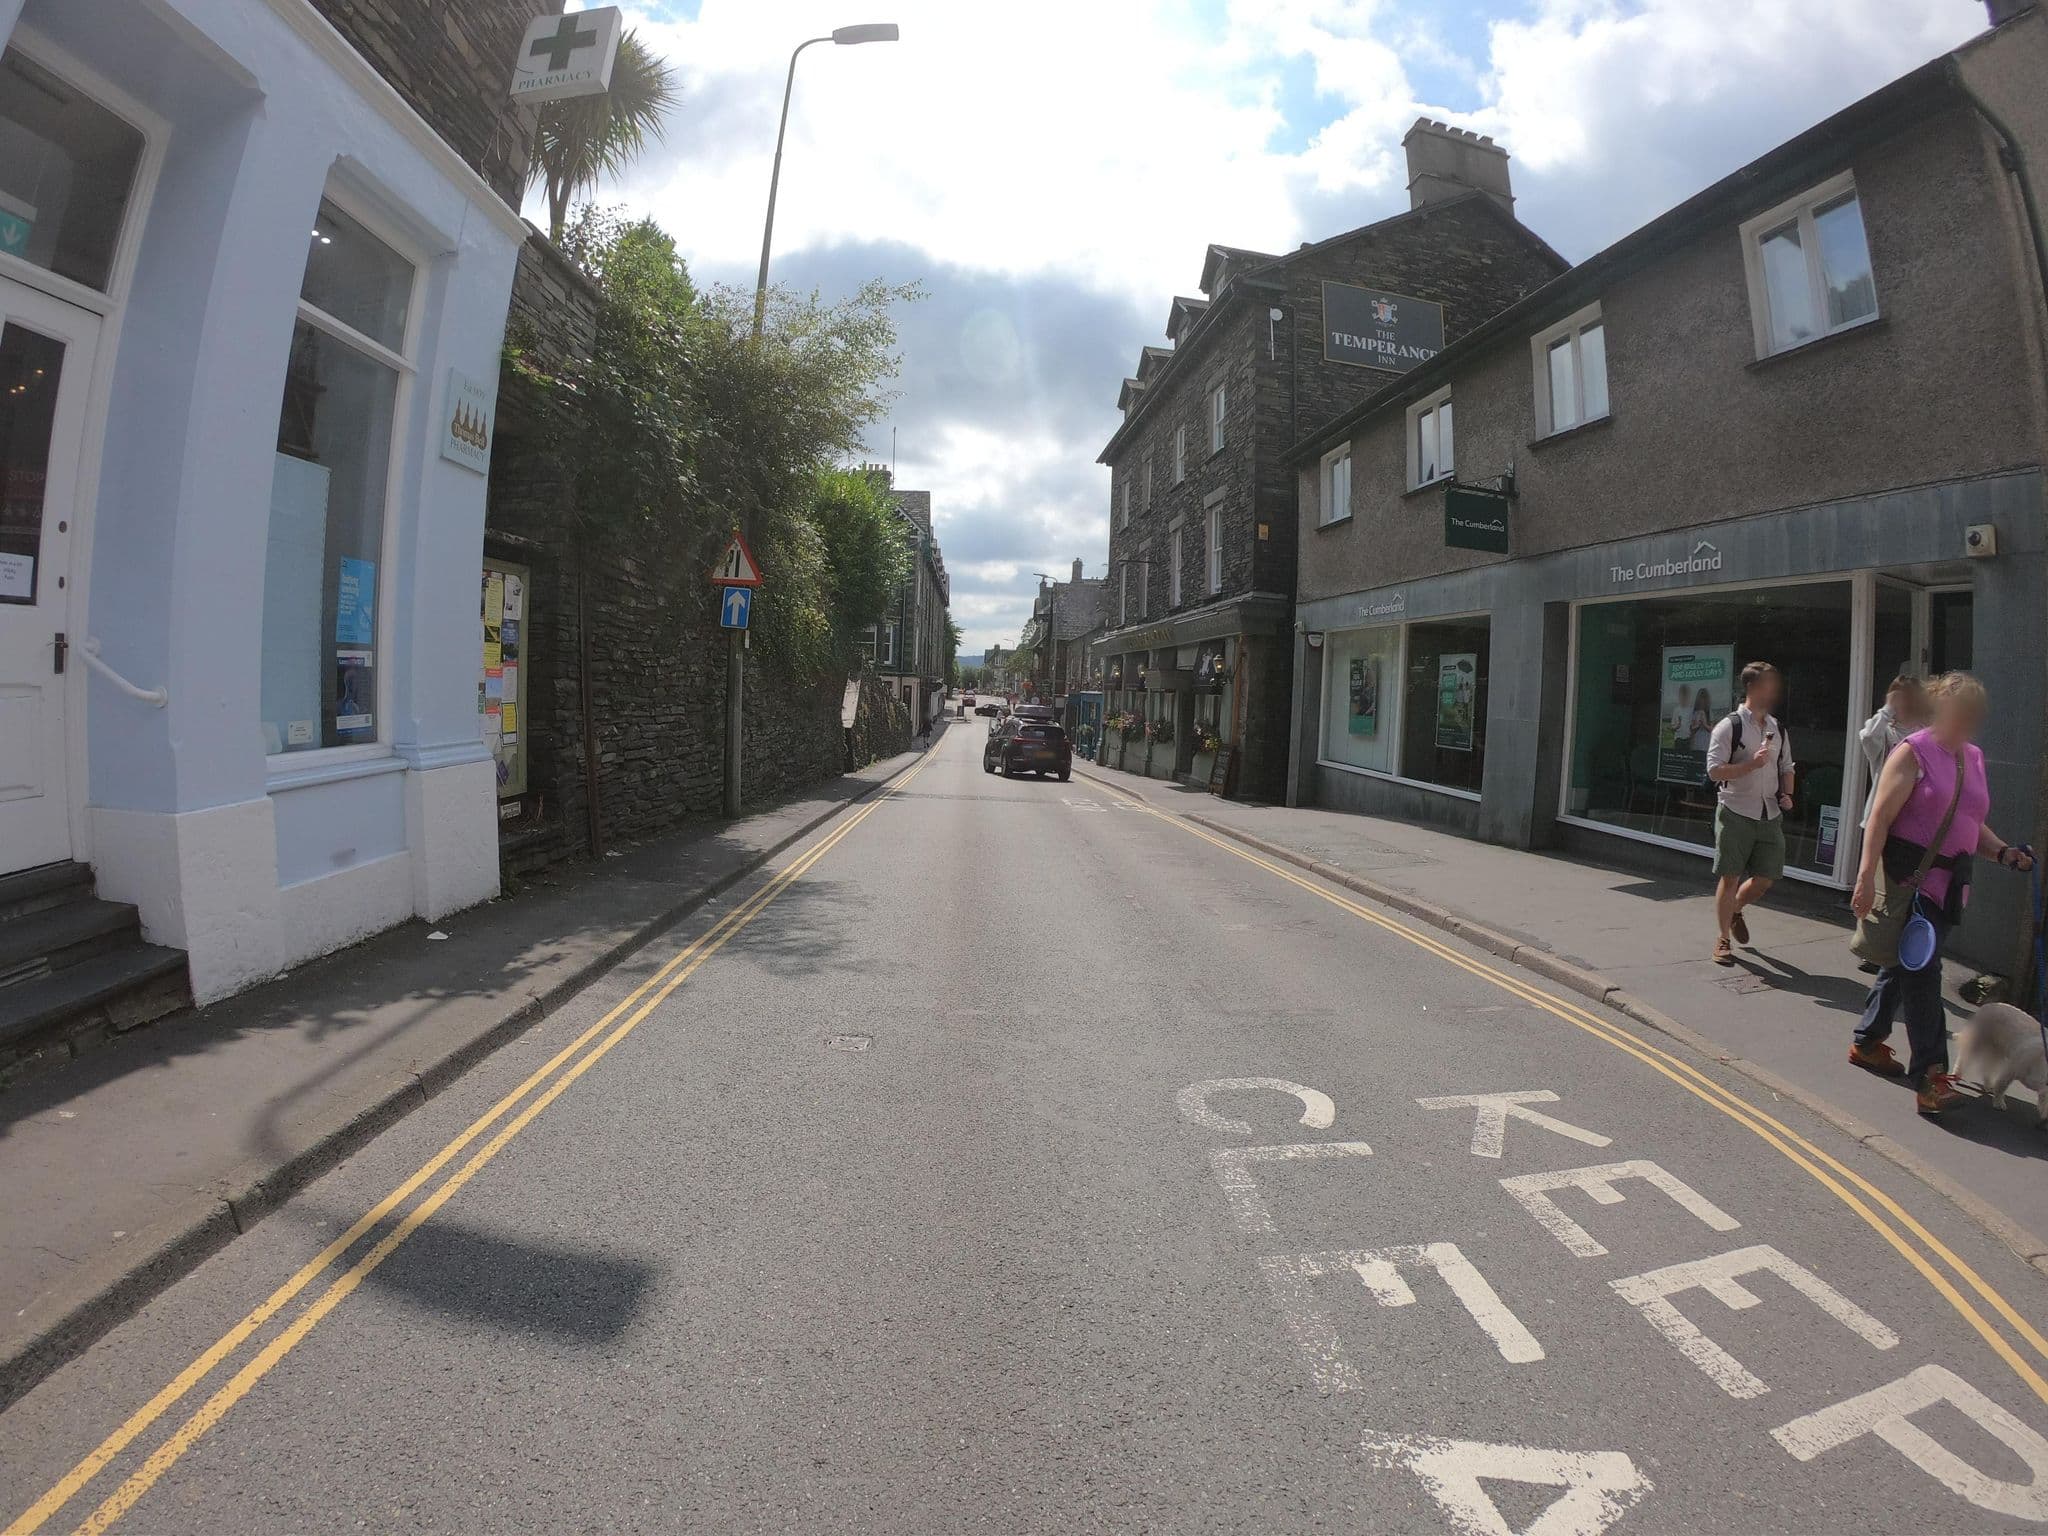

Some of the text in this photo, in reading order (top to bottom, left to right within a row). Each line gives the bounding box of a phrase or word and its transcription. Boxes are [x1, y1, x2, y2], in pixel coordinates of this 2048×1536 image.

[518, 71, 592, 90] PHARMACY
[1376, 329, 1396, 341] THE
[1378, 354, 1396, 366] INN
[450, 438, 487, 462] PHARMACY
[1450, 517, 1504, 532] The Cumberland
[1611, 551, 1722, 582] The Cumberland
[1359, 600, 1405, 617] The Cumberland
[1415, 1089, 2048, 1521] KEEP
